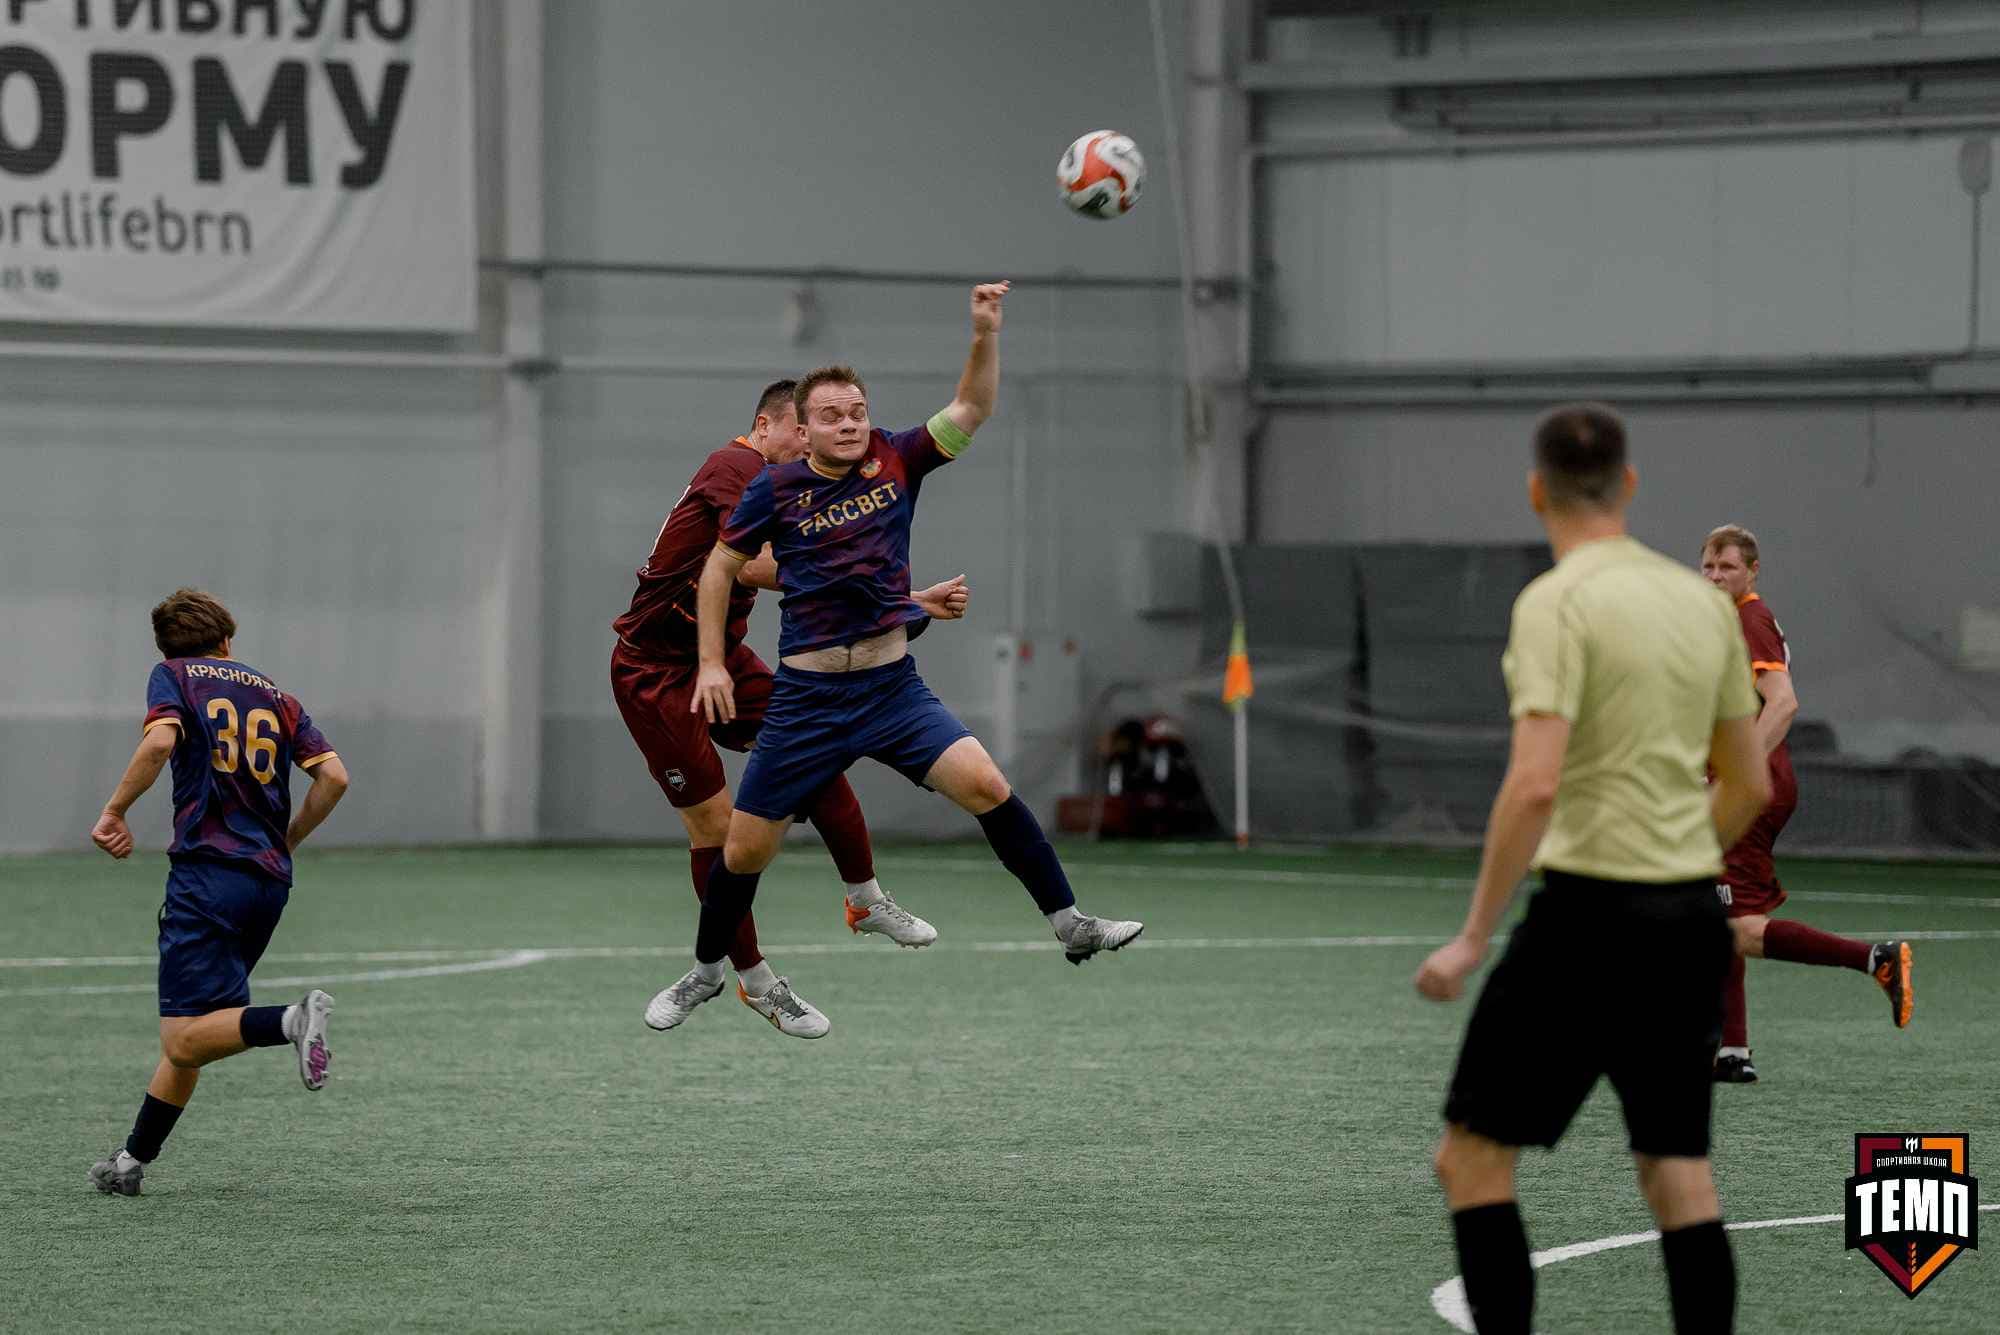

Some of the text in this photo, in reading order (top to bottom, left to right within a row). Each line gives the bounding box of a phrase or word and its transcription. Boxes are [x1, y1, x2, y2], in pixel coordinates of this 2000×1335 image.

[0, 44, 412, 190] ОРМУ
[0, 189, 252, 254] rtlifebrn
[185, 664, 283, 699] КРАСНОЯР
[206, 697, 281, 785] 36
